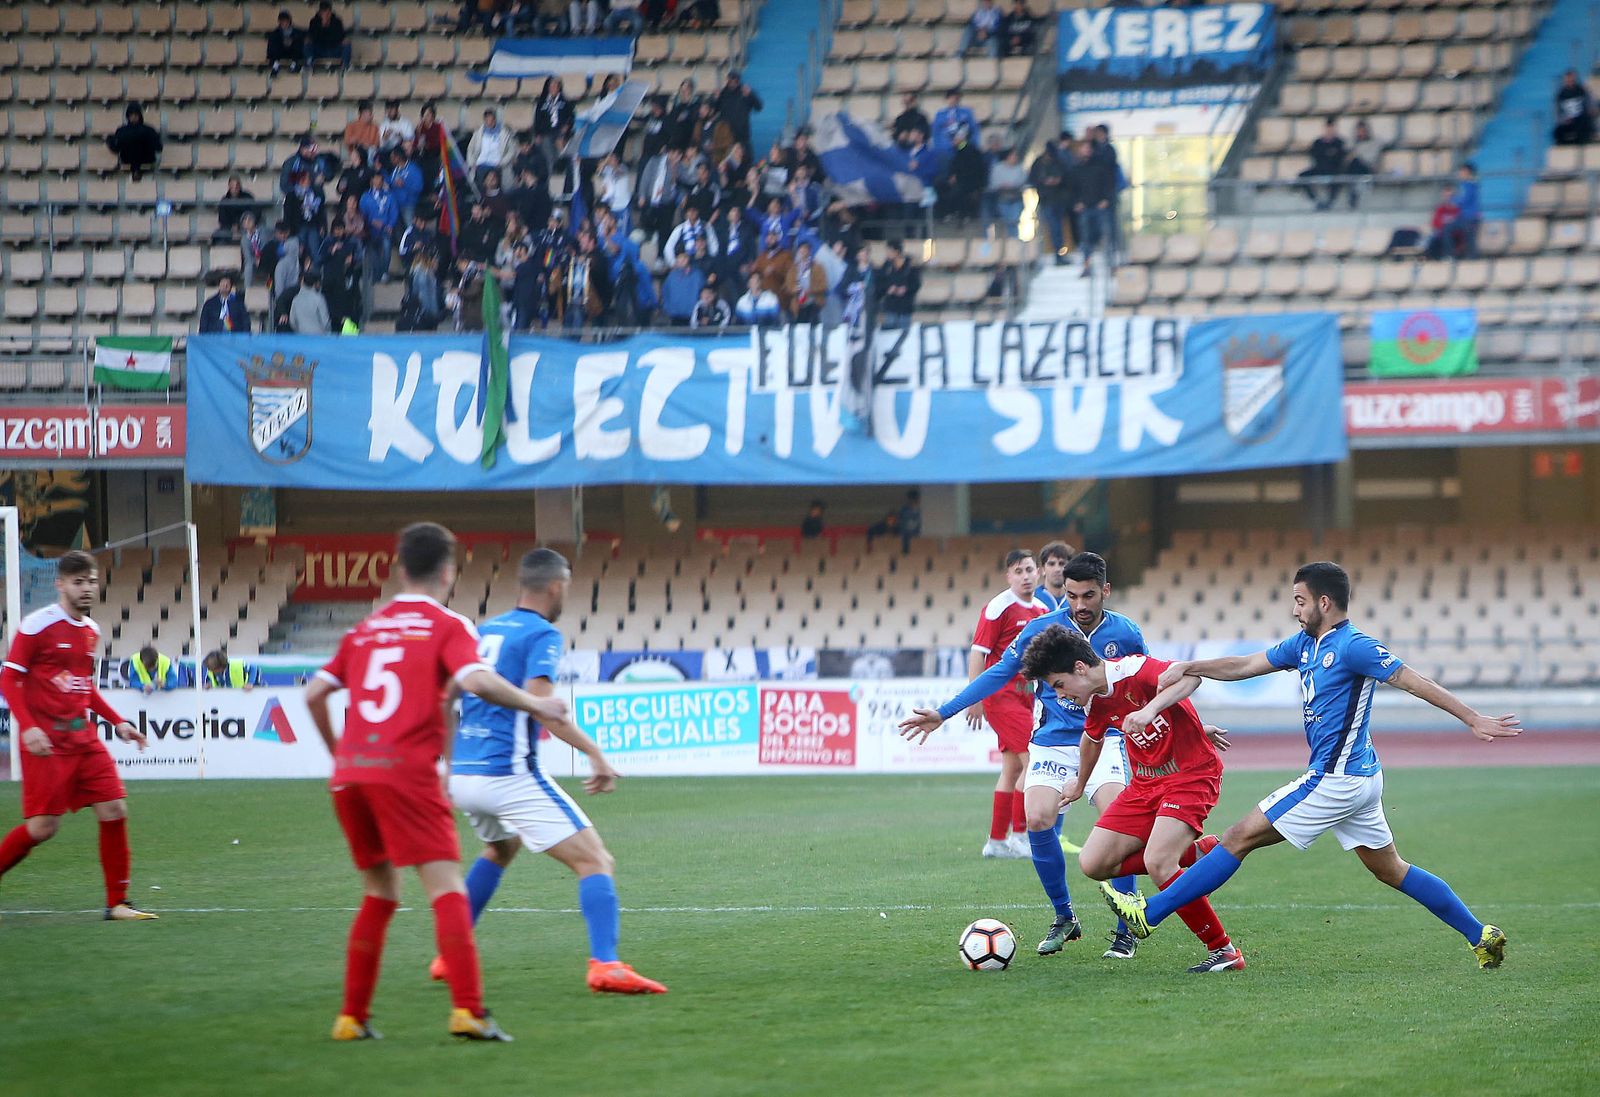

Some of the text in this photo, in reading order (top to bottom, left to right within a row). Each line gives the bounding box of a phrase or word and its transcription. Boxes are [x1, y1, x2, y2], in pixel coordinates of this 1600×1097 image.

[1066, 3, 1264, 62] XEREZ
[757, 319, 1182, 387] FUEZA CAZALLA
[0, 414, 142, 456] zcampo
[297, 551, 398, 588] ruzc
[358, 646, 405, 724] 5
[583, 690, 750, 726] DESCUENTOS
[764, 691, 824, 713] PARA
[868, 699, 905, 718] 956
[596, 717, 741, 750] ESPECIALES
[763, 712, 850, 736] SOCIOS
[762, 751, 832, 763] DEPORTIVO
[763, 736, 784, 750] DEL
[114, 755, 175, 767] eguradora
